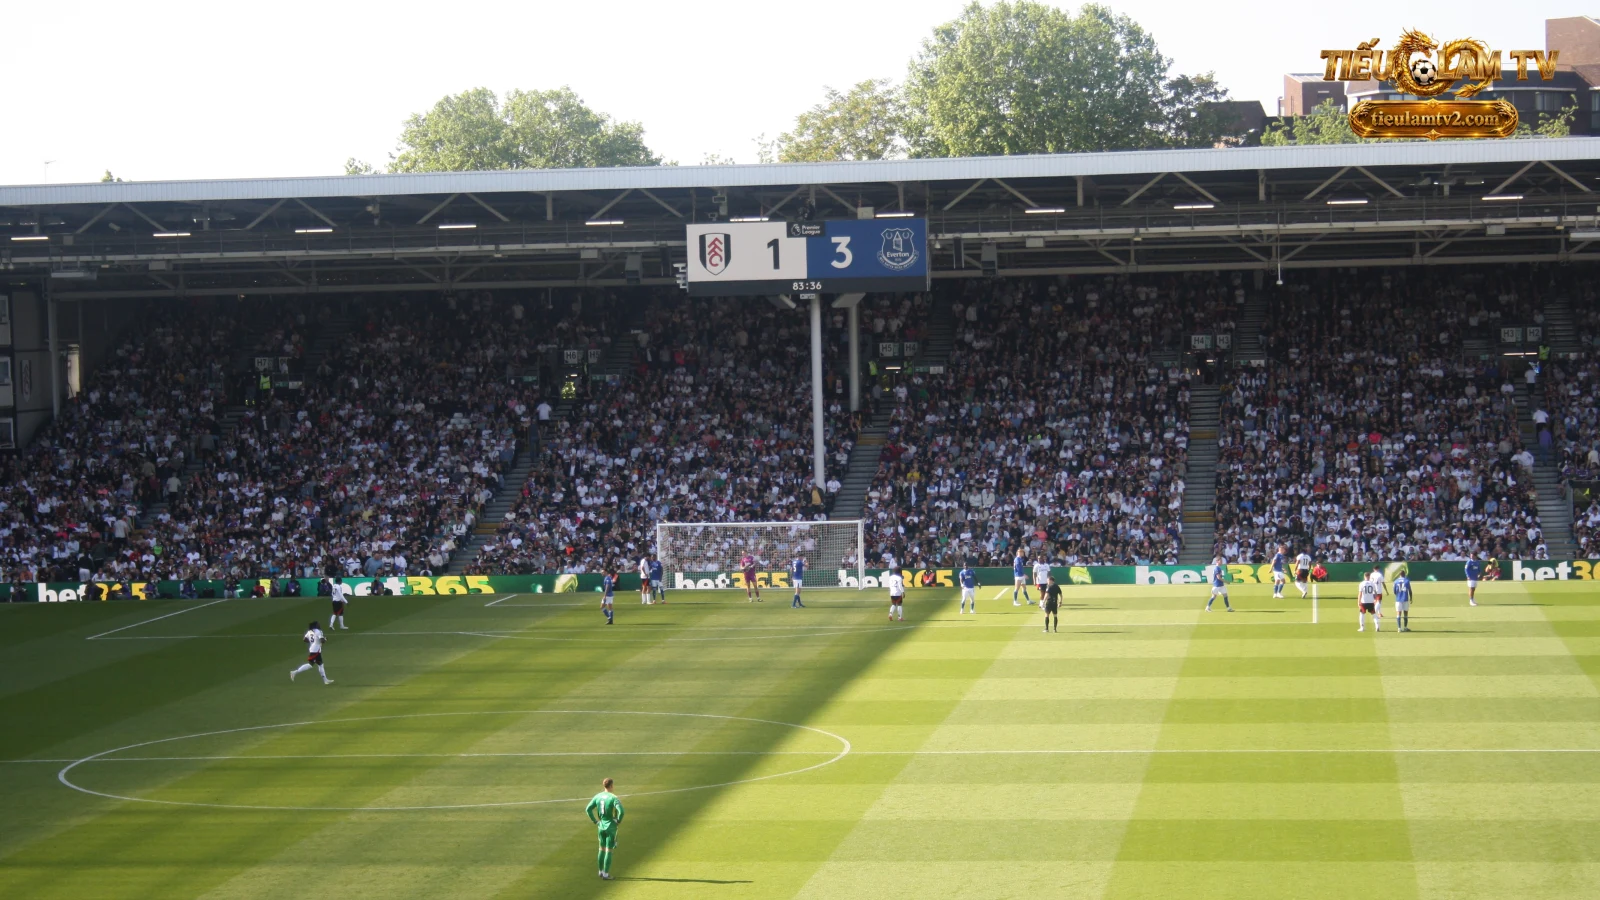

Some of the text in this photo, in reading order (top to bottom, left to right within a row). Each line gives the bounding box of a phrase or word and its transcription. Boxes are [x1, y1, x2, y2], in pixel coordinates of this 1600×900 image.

[767, 238, 780, 270] 1
[831, 236, 853, 269] 3
[792, 282, 822, 291] 83:36
[1503, 328, 1539, 338] H3 H2
[1193, 336, 1228, 345] H4 H3
[881, 343, 915, 352] H5 H4
[565, 351, 576, 360] H6
[256, 358, 267, 367] H7
[674, 572, 789, 589] bet365
[1364, 585, 1374, 595] 10
[1396, 582, 1407, 592] 14
